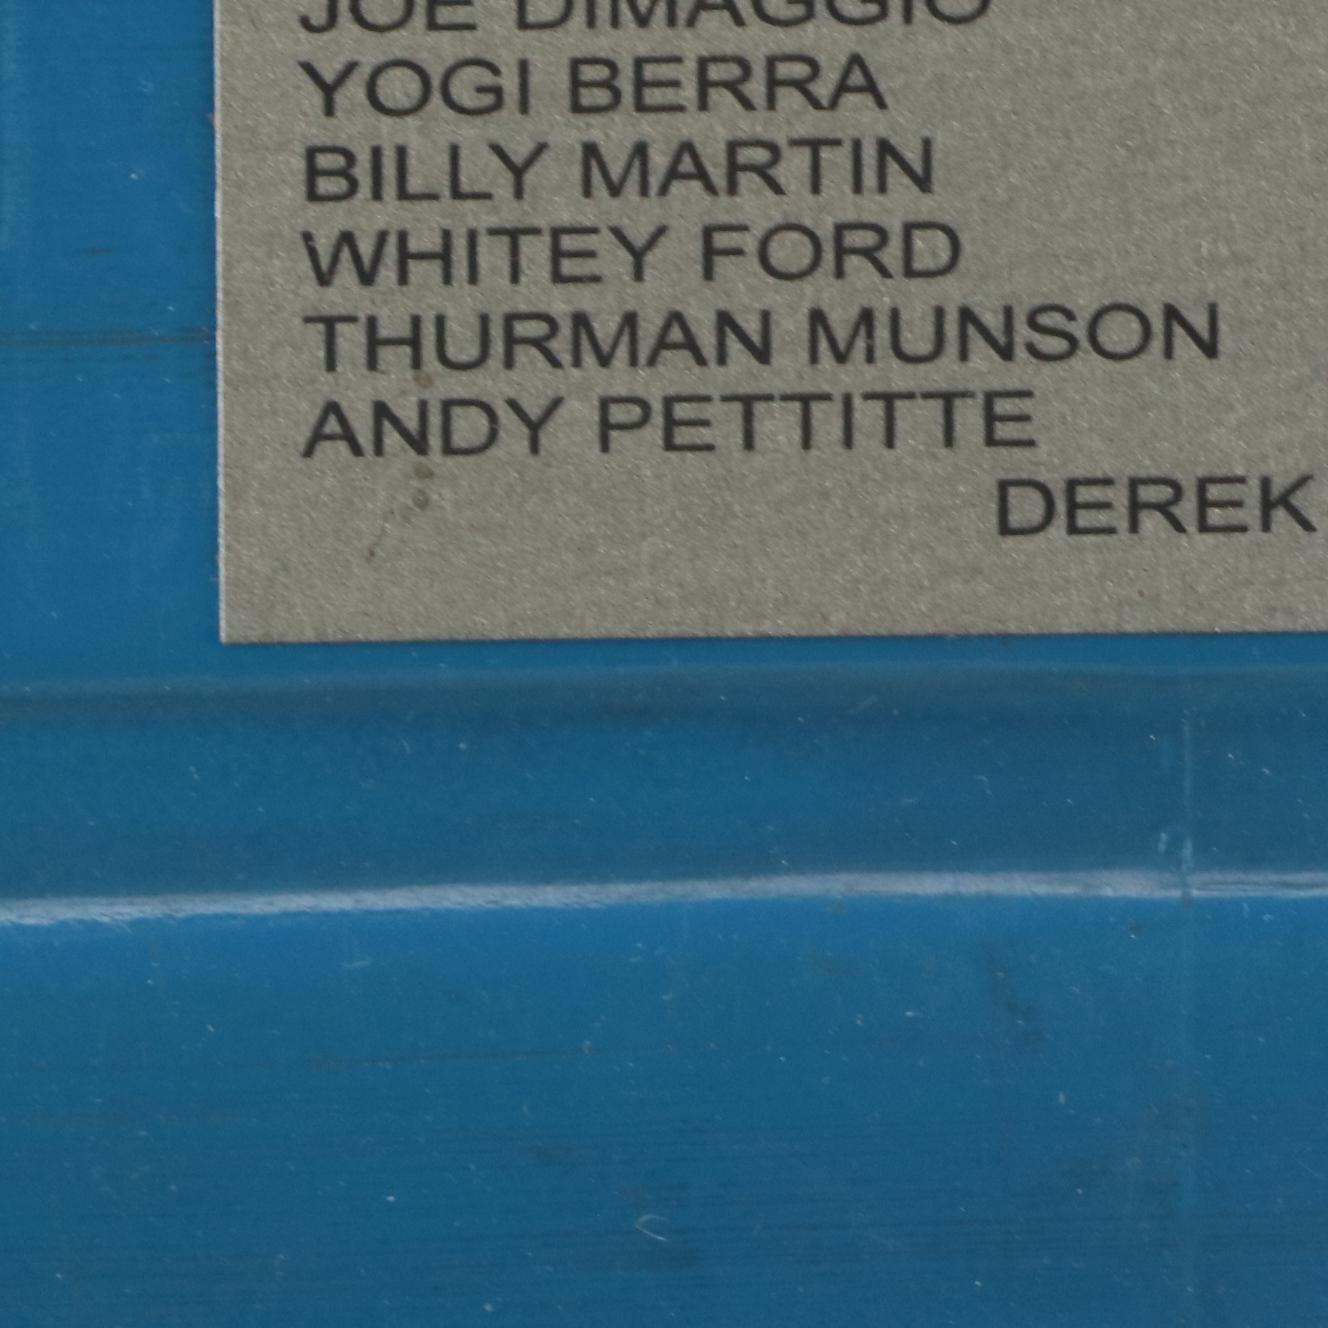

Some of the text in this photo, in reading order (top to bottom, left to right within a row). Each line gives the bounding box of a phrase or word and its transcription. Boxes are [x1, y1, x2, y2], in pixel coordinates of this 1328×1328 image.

[299, 52, 888, 119] YOGI BERRA
[304, 136, 934, 204] BILLY MARTIN
[301, 220, 963, 288] WHITEY FORD
[303, 301, 1220, 374] THURMAN MUNSON
[301, 388, 1037, 459] ANDY PETTITTE
[996, 473, 1316, 538] DEREK
